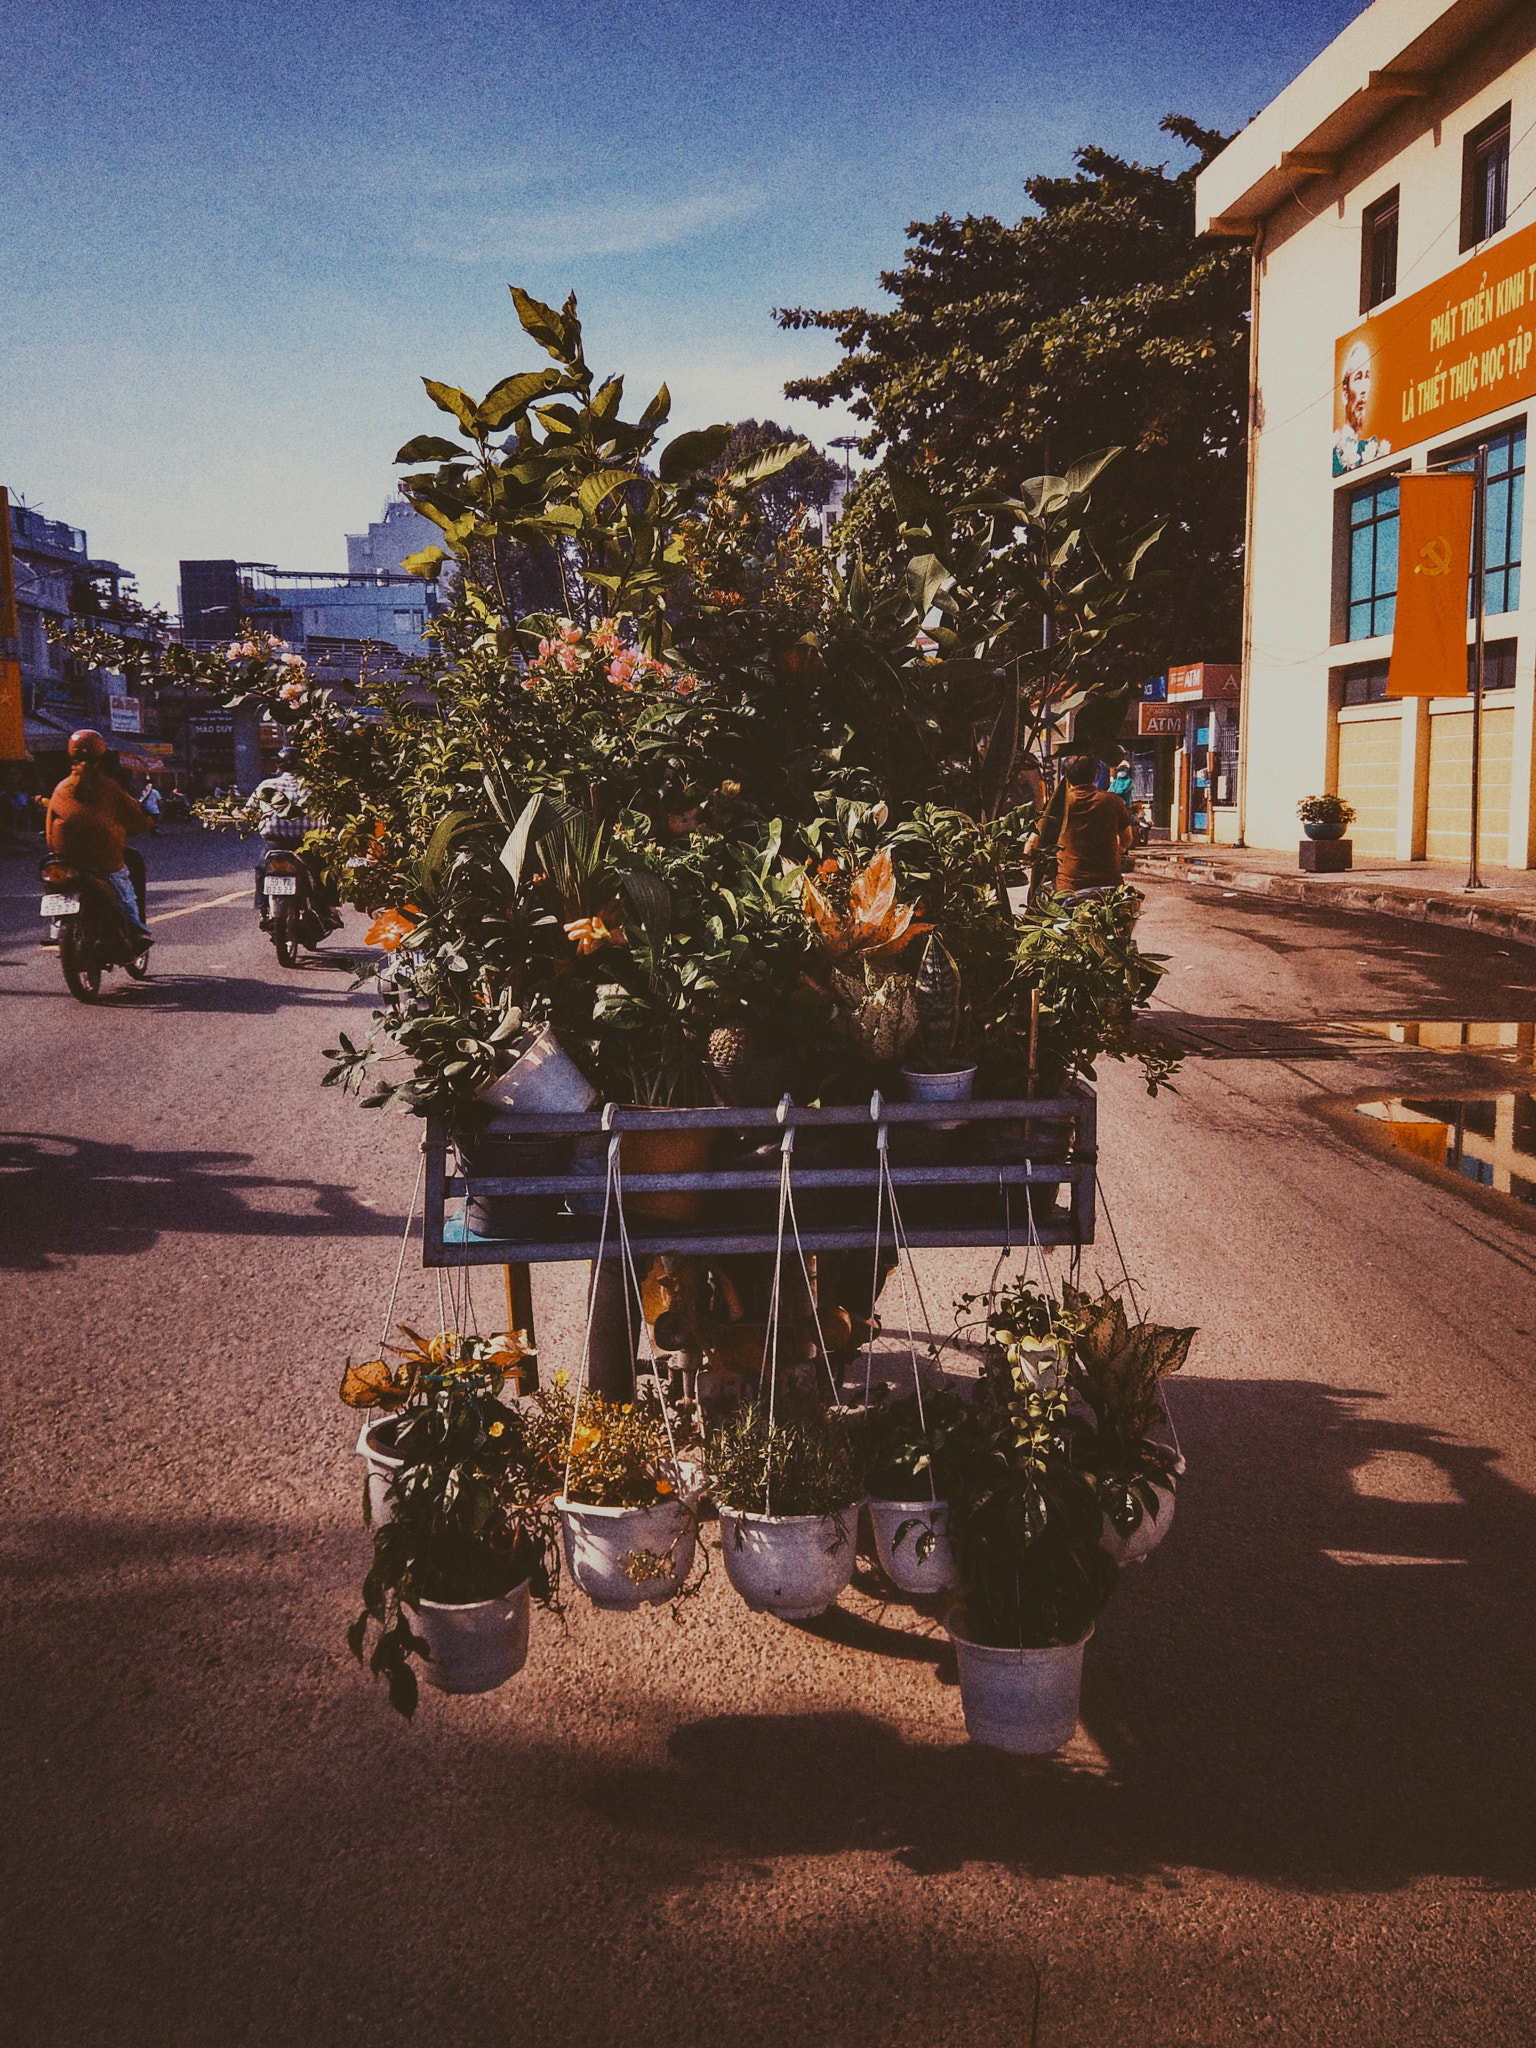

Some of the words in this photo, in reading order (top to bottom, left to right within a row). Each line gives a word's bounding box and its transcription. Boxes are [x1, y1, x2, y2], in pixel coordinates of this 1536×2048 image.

[1430, 300, 1458, 352] PHÁT
[1460, 271, 1494, 336] TRIỂN
[1496, 269, 1525, 318] KINH
[1528, 263, 1536, 302] T
[1402, 379, 1414, 423] LÀ
[1417, 359, 1448, 416] THIẾT
[1449, 351, 1479, 402] THỰC
[1481, 343, 1505, 391] HỌC
[1508, 325, 1533, 379] TẬP
[1184, 668, 1201, 688] ATM
[1147, 717, 1181, 731] ATM
